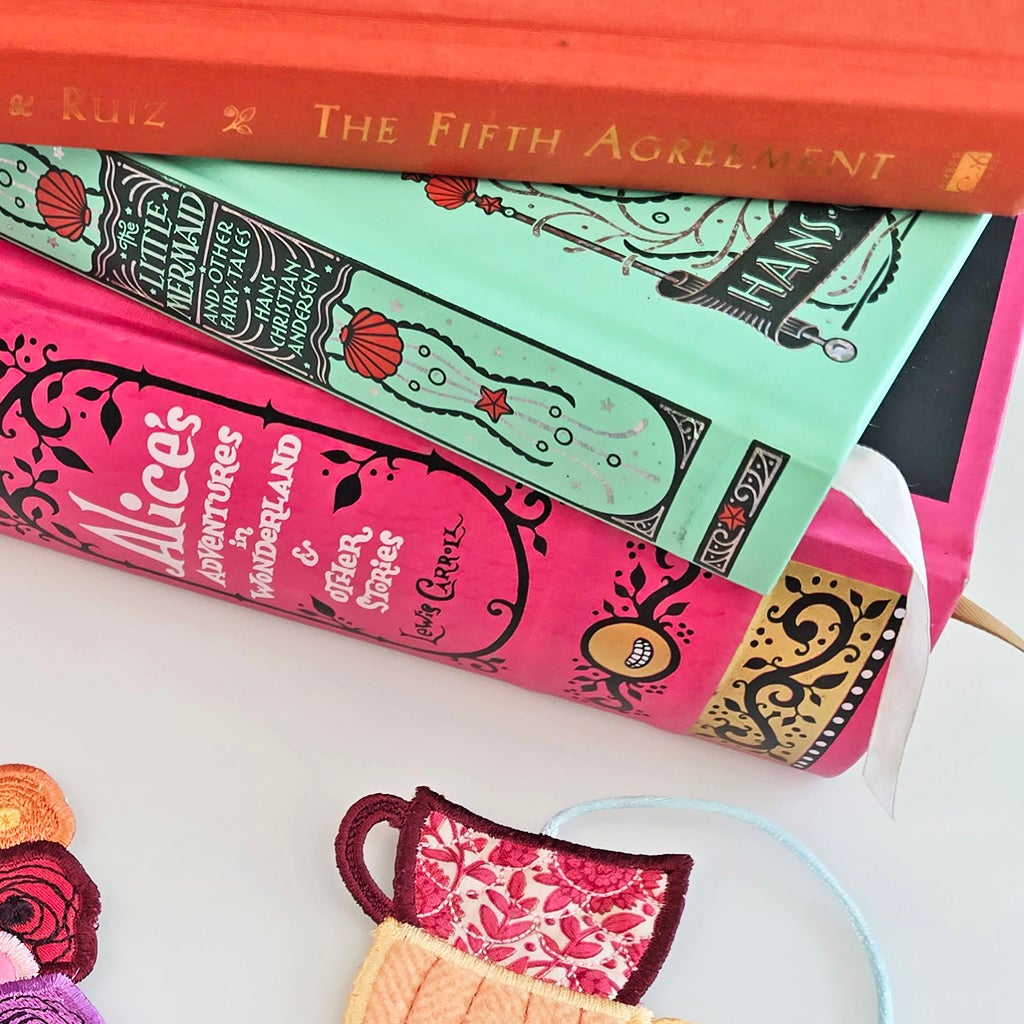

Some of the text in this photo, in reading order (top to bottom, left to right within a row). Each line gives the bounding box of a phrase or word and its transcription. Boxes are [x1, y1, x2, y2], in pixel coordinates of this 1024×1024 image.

[8, 93, 34, 118] &
[61, 86, 166, 129] RUIZ
[314, 103, 398, 145] THE
[427, 111, 563, 156] FIFTH
[583, 124, 896, 181] AGREEMENT
[139, 200, 174, 292] LITTLE
[166, 191, 206, 322] MERMAID
[254, 273, 277, 323] HANS
[270, 258, 302, 348] CHRISTIAN
[287, 267, 320, 357] ANDERSEN
[67, 405, 202, 578] Alice's
[228, 526, 255, 550] in
[291, 539, 319, 567] &
